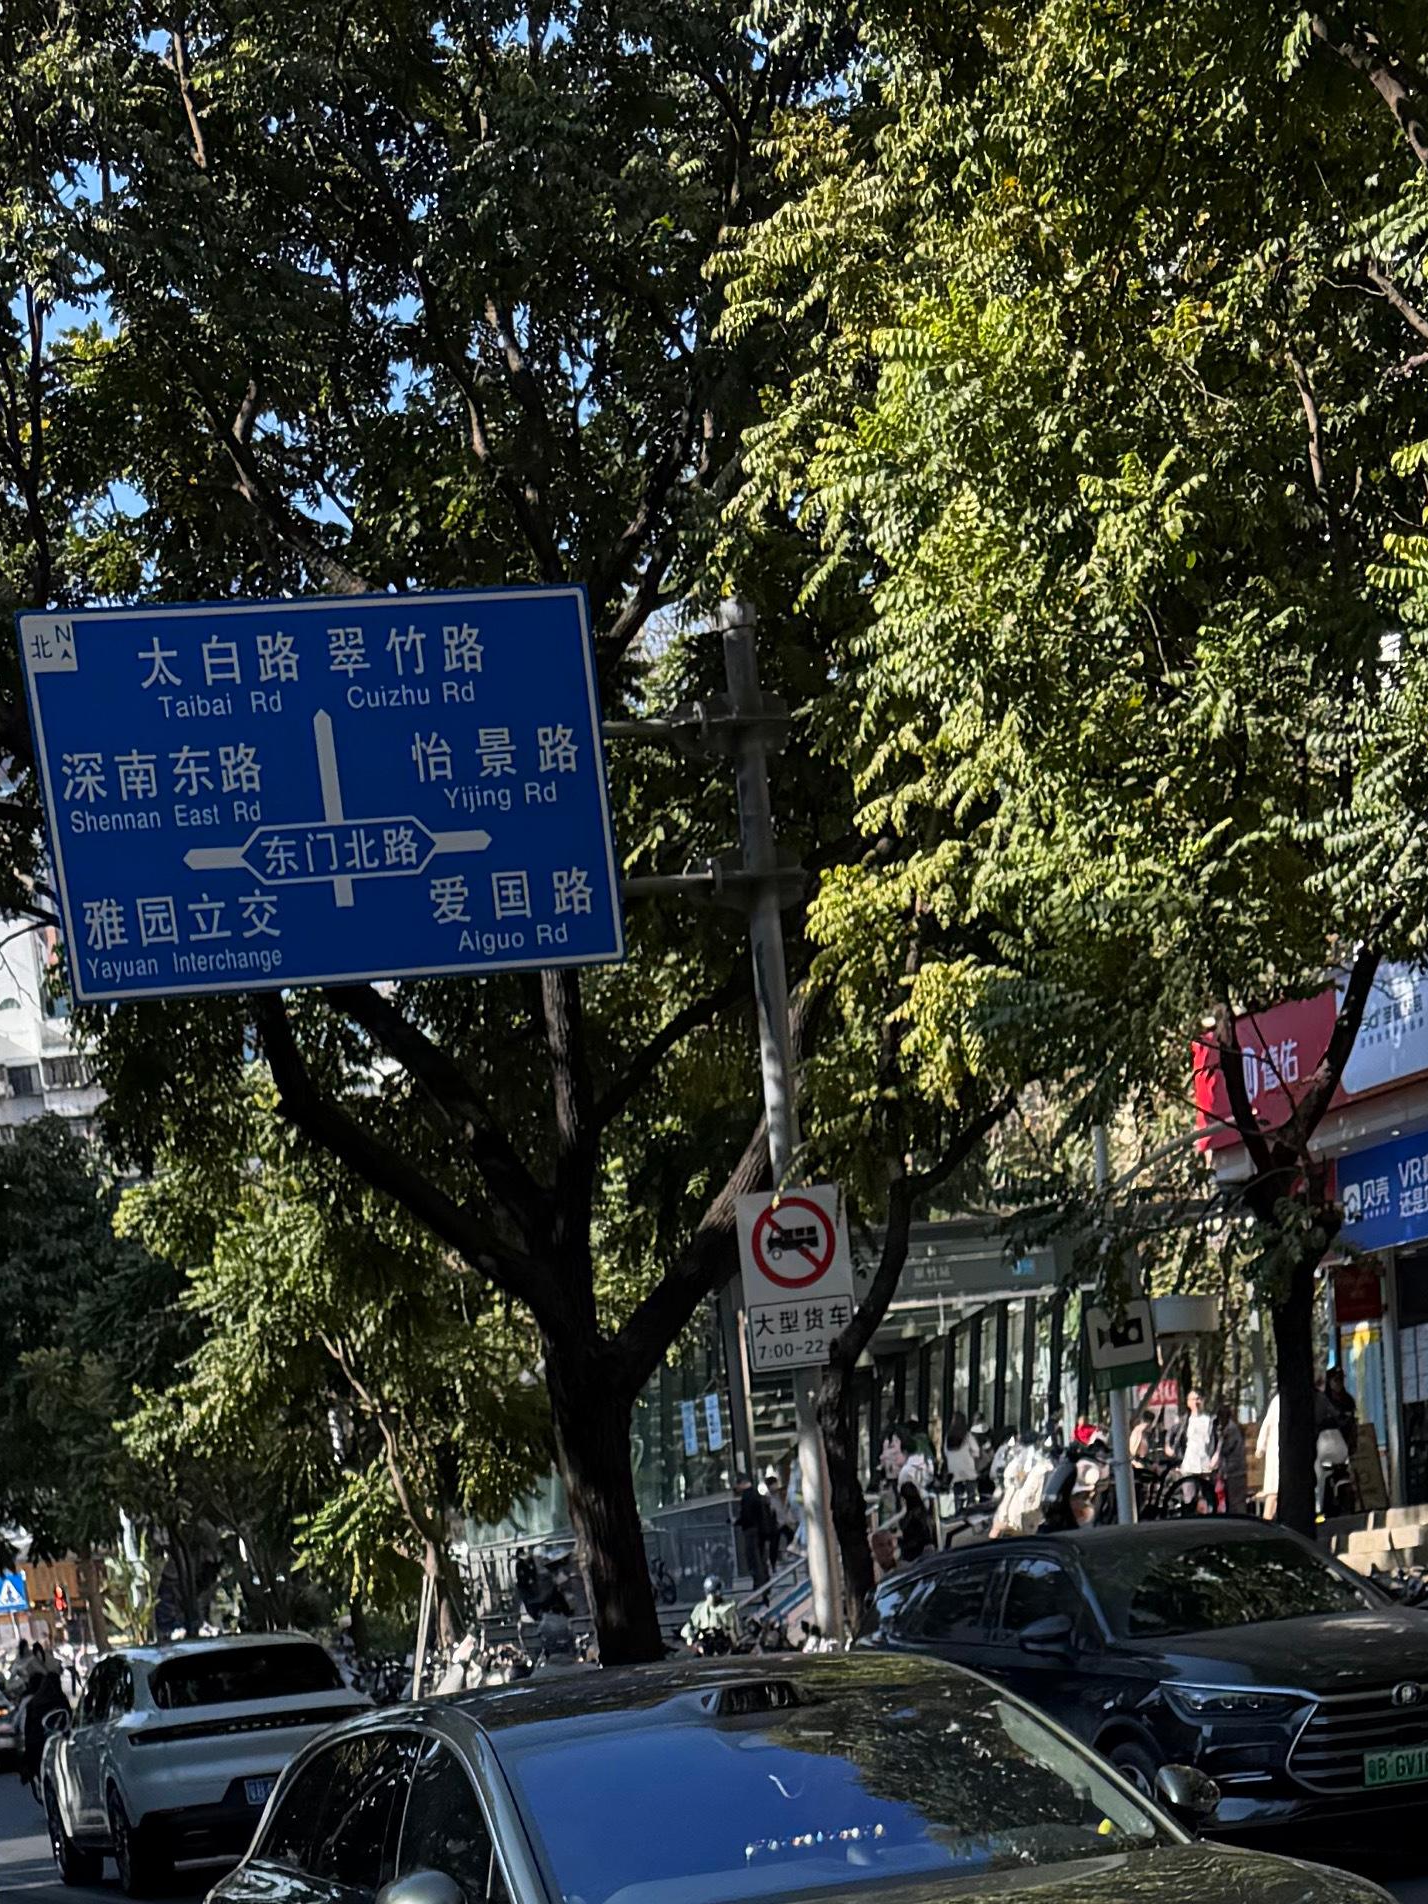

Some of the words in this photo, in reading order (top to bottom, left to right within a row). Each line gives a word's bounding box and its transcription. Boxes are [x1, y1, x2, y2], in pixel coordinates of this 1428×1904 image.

[55, 624, 72, 643] N
[137, 630, 301, 690] 太白路
[327, 622, 485, 678] 翠竹路
[158, 692, 233, 720] Taibai
[251, 689, 283, 715] Rd
[346, 683, 430, 711] Cuizhu
[443, 680, 475, 704] Rd
[411, 723, 579, 783] 怡景路
[61, 741, 263, 803] 深南东路
[442, 786, 511, 814] Yijing
[524, 781, 558, 805] Rd
[70, 808, 162, 834] Shennan
[175, 804, 221, 827] East
[233, 799, 261, 824] Rd
[259, 825, 421, 877] 东门北路
[429, 866, 594, 926] 爱国路
[83, 888, 282, 951] 雅园立交
[459, 926, 526, 956] Aiguo
[537, 922, 568, 947] Rd
[86, 952, 159, 982] Yayuan
[173, 946, 283, 974] Interchange
[1362, 1176, 1390, 1211] 贝壳
[754, 1303, 850, 1338] 大型货车
